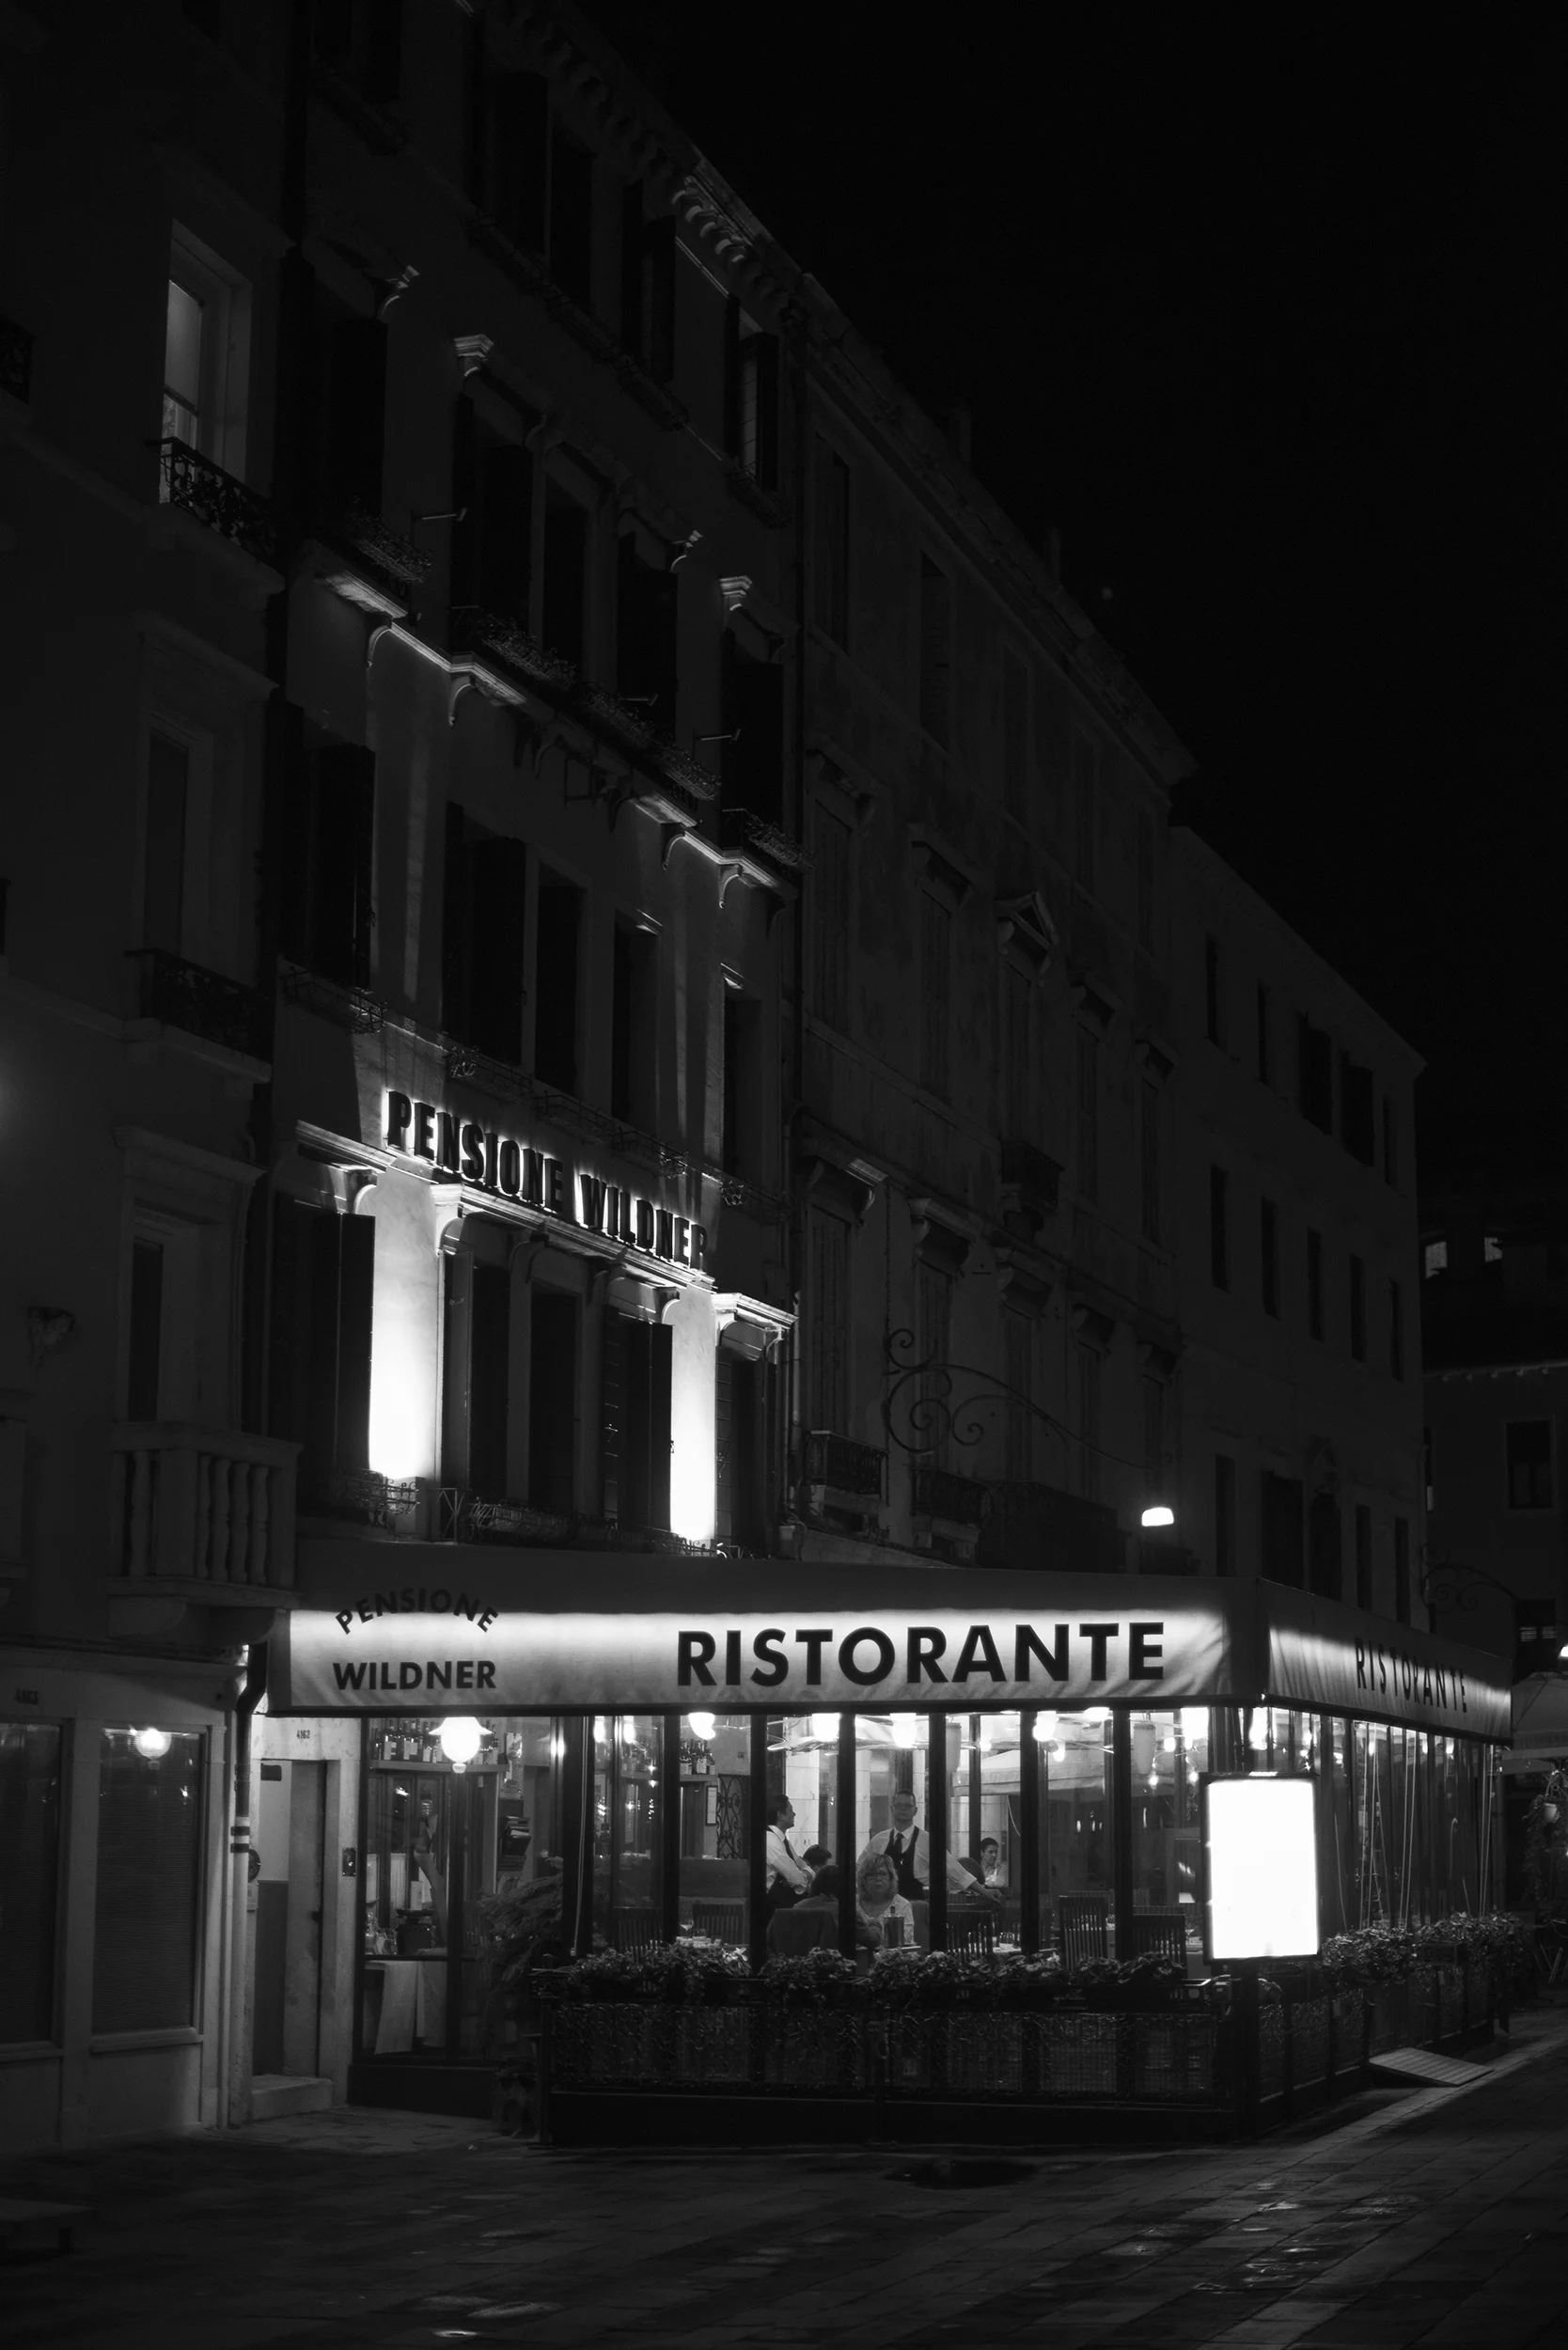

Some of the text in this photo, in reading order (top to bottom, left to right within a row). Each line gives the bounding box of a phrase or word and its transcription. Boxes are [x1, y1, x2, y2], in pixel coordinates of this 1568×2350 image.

[387, 1090, 708, 1270] PENSIONE WILDNER
[336, 1588, 498, 1635] PENSIONE
[332, 1660, 497, 1690] WILDNER
[677, 1622, 1165, 1686] RISTORANTE
[1355, 1636, 1467, 1714] RISTORANTE
